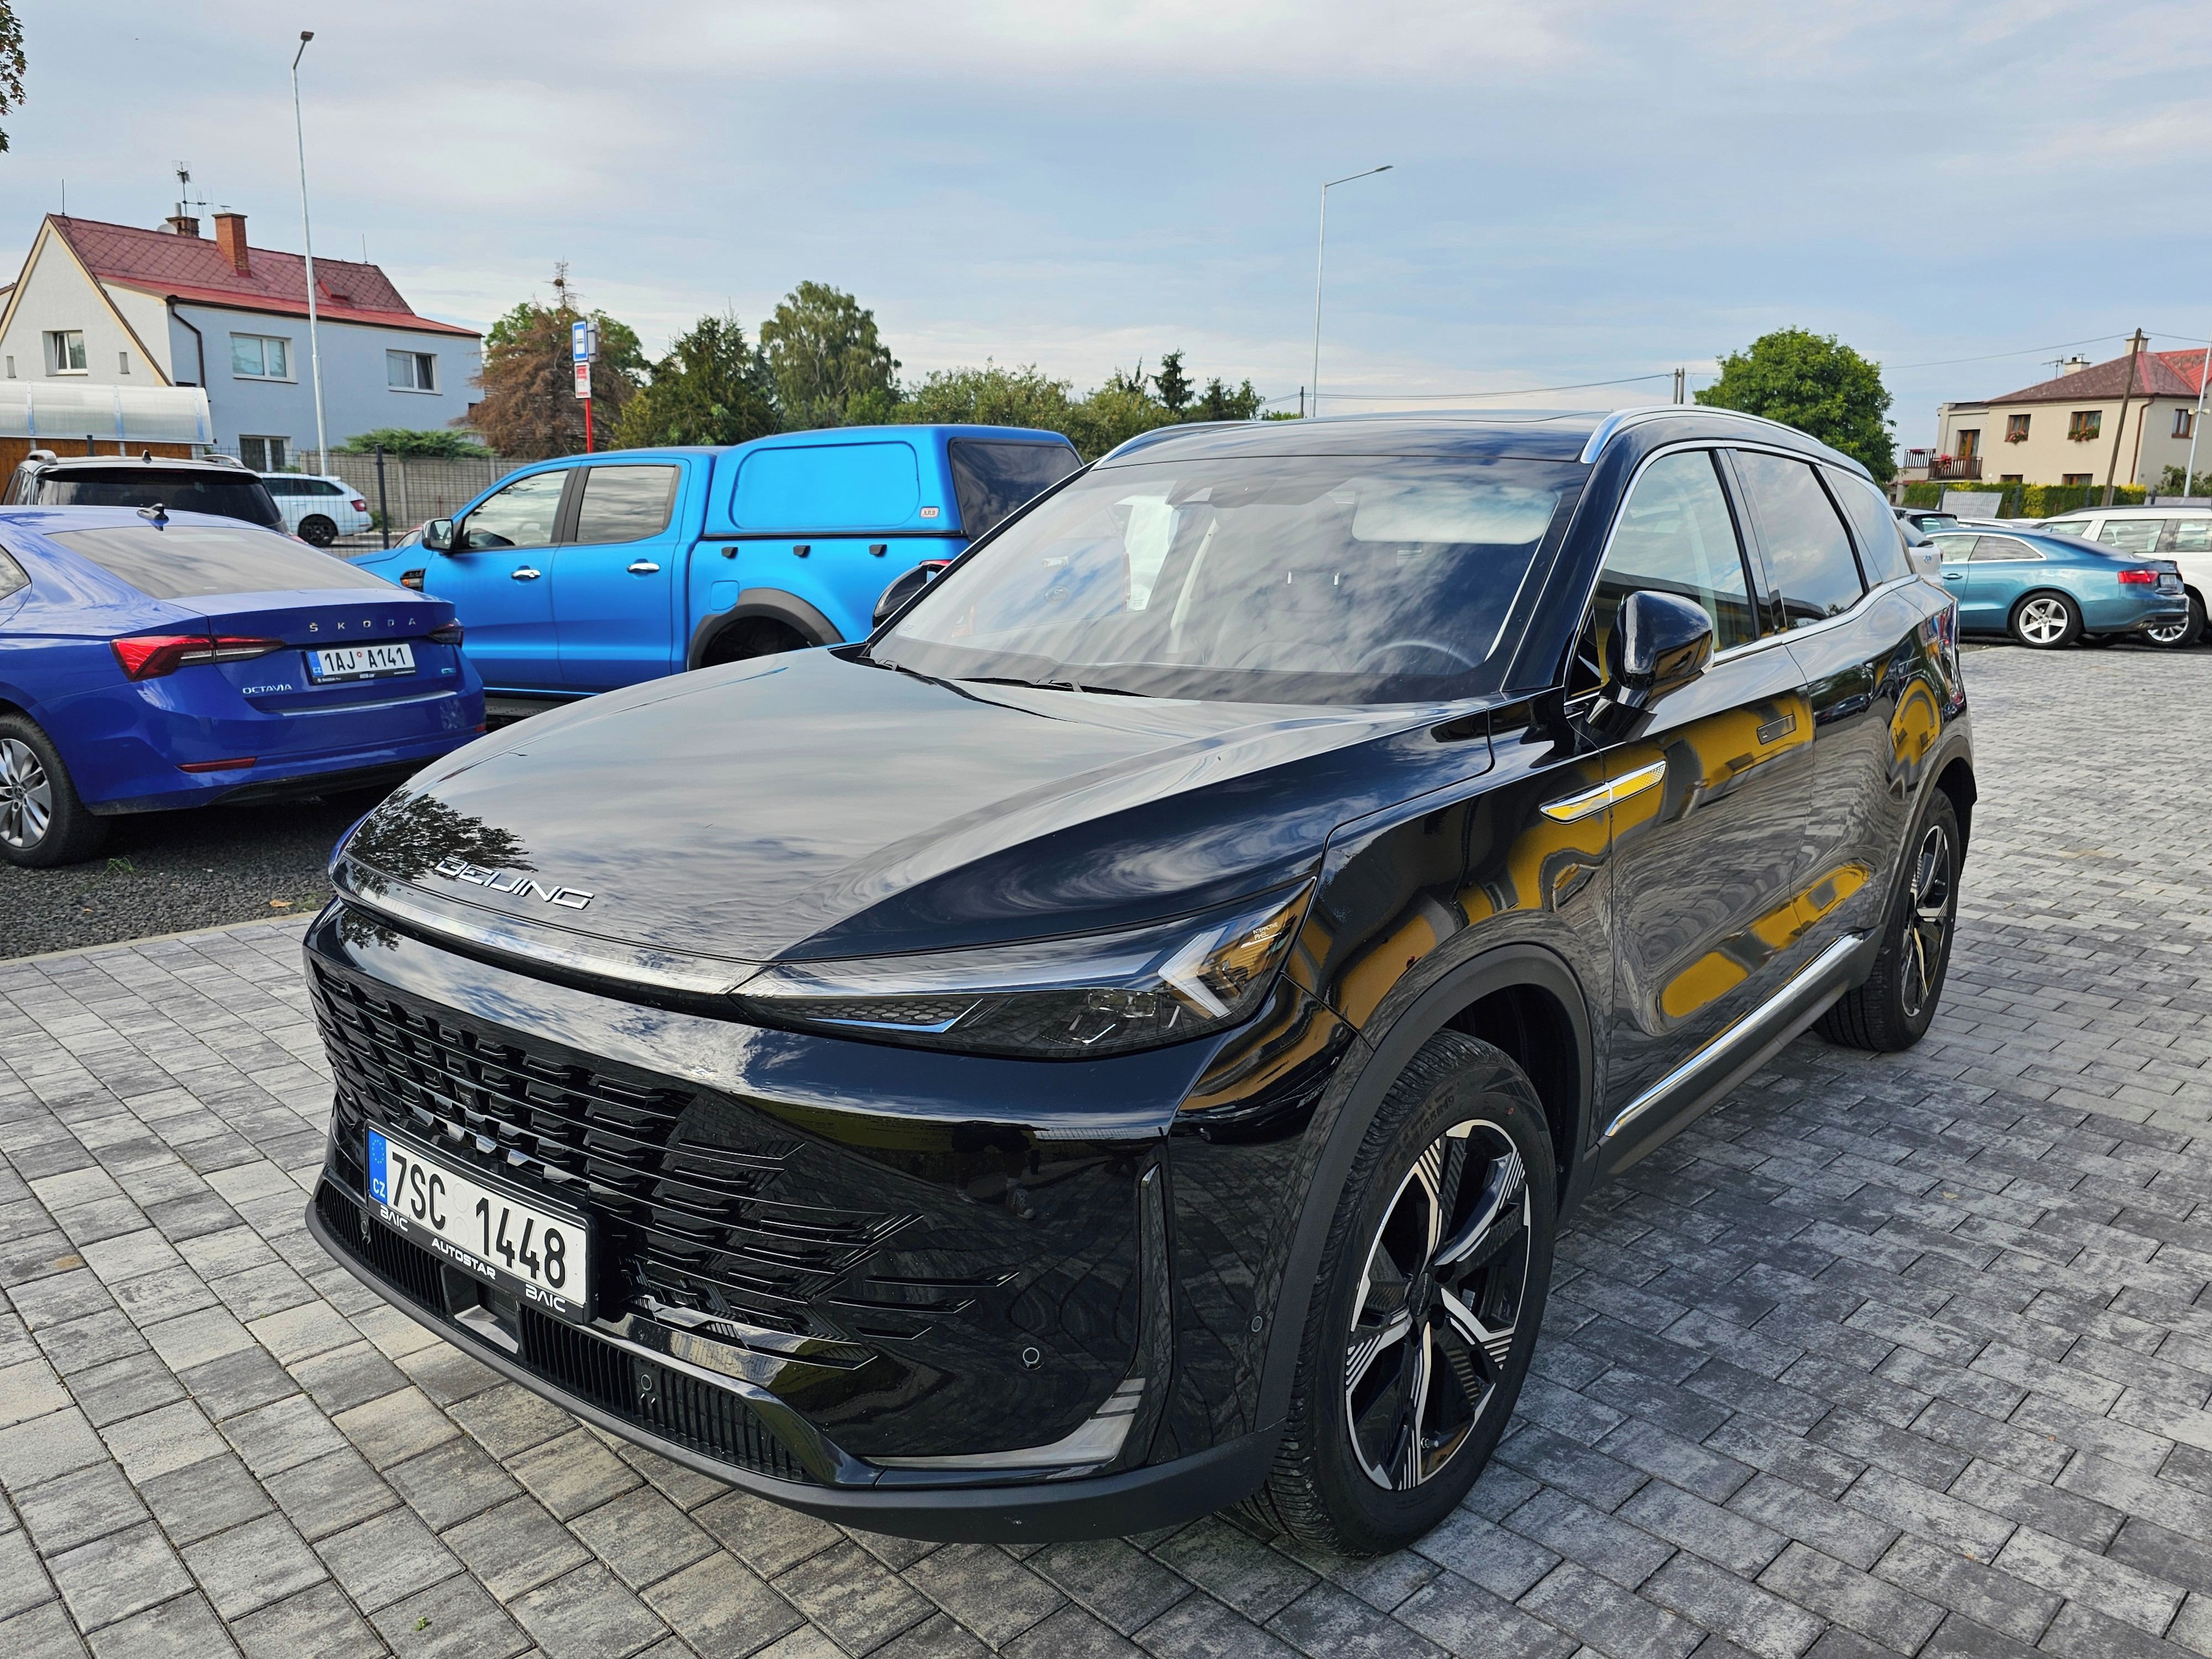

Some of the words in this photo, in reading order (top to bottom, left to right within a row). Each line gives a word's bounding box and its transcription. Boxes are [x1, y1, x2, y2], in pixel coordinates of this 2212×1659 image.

[309, 618, 416, 632] ŠKODA
[324, 651, 356, 672] 1AJ
[367, 647, 406, 669] A141
[242, 684, 293, 695] OCTAVIA
[435, 856, 594, 910] BEIJING
[373, 1177, 386, 1198] CZ
[392, 1151, 445, 1231] 7SC
[476, 1197, 566, 1290] 1448
[380, 1204, 409, 1232] BAIC
[431, 1237, 496, 1280] AUTOSTAR
[525, 1284, 567, 1313] BAIC
